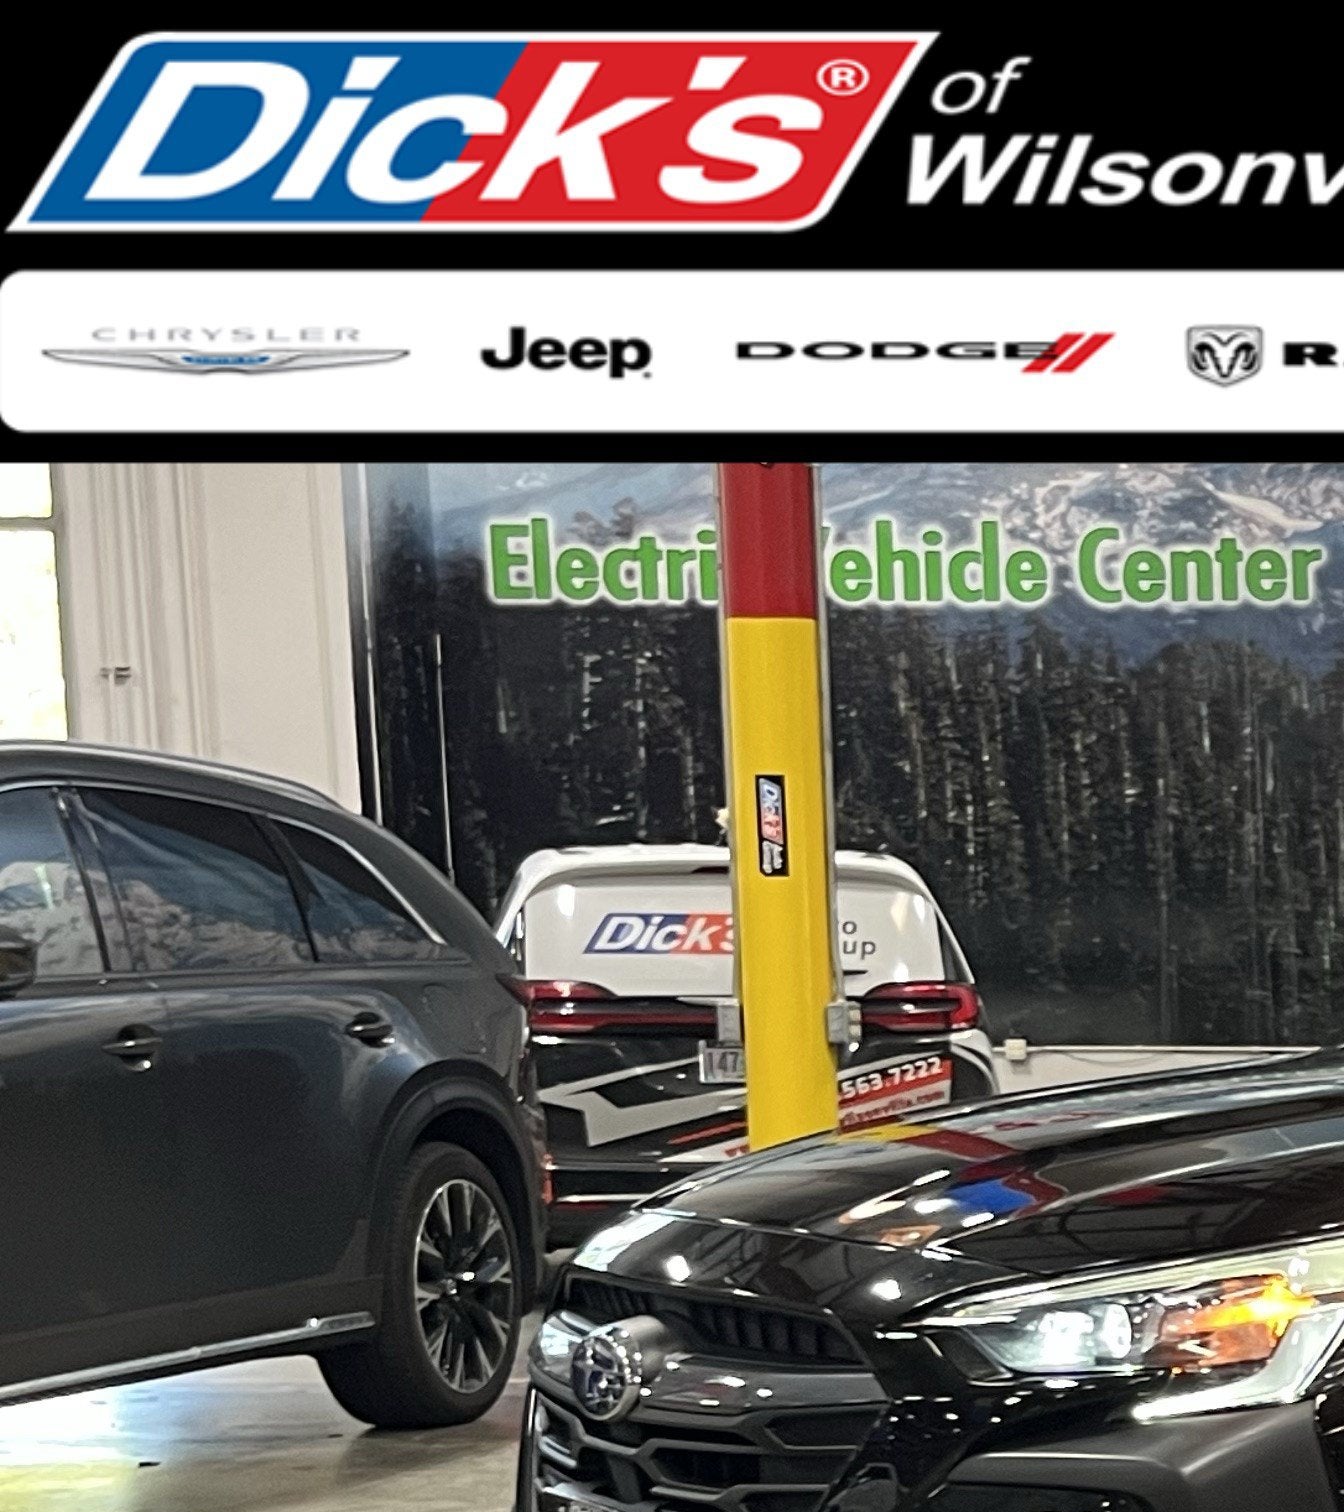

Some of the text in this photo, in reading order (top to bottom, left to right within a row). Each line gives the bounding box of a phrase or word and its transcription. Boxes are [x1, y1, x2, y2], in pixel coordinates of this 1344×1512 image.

[491, 517, 1318, 602] Electri ehicle Center
